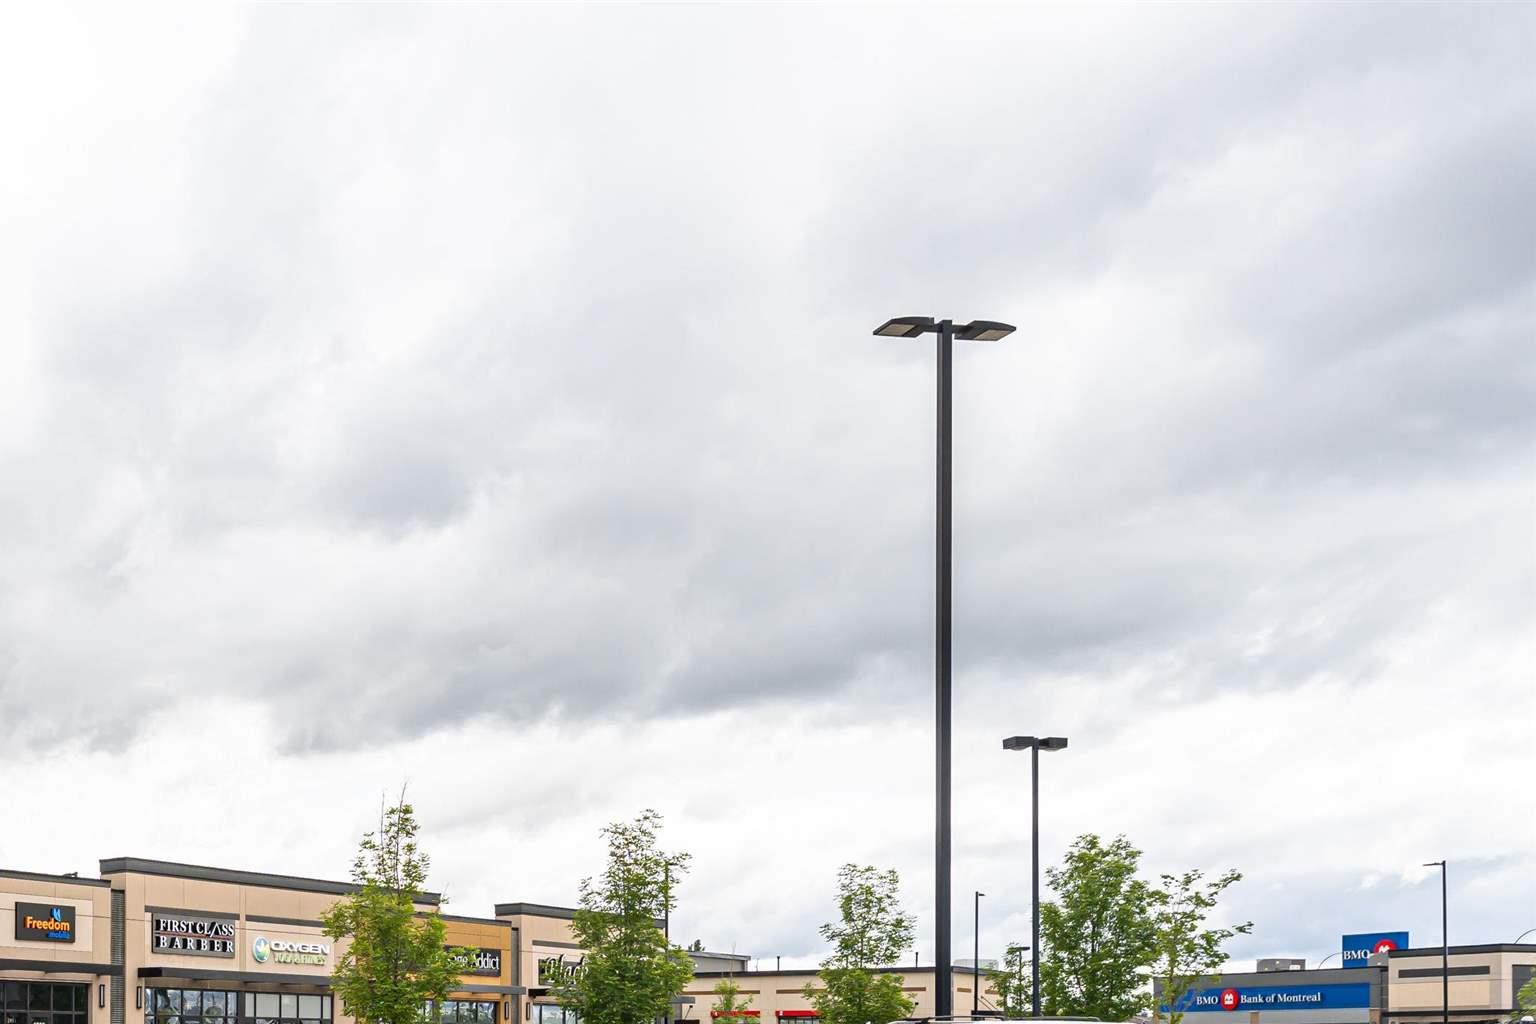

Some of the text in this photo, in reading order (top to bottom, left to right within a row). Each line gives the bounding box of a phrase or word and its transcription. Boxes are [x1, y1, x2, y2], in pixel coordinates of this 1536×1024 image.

[26, 916, 70, 931] Freedom
[159, 919, 234, 938] FIRST CLASS
[159, 935, 234, 953] BARBER
[271, 941, 330, 955] OXYGEN
[1344, 949, 1370, 961] BMO
[1196, 992, 1321, 1005] BMO Bank of Montreal
